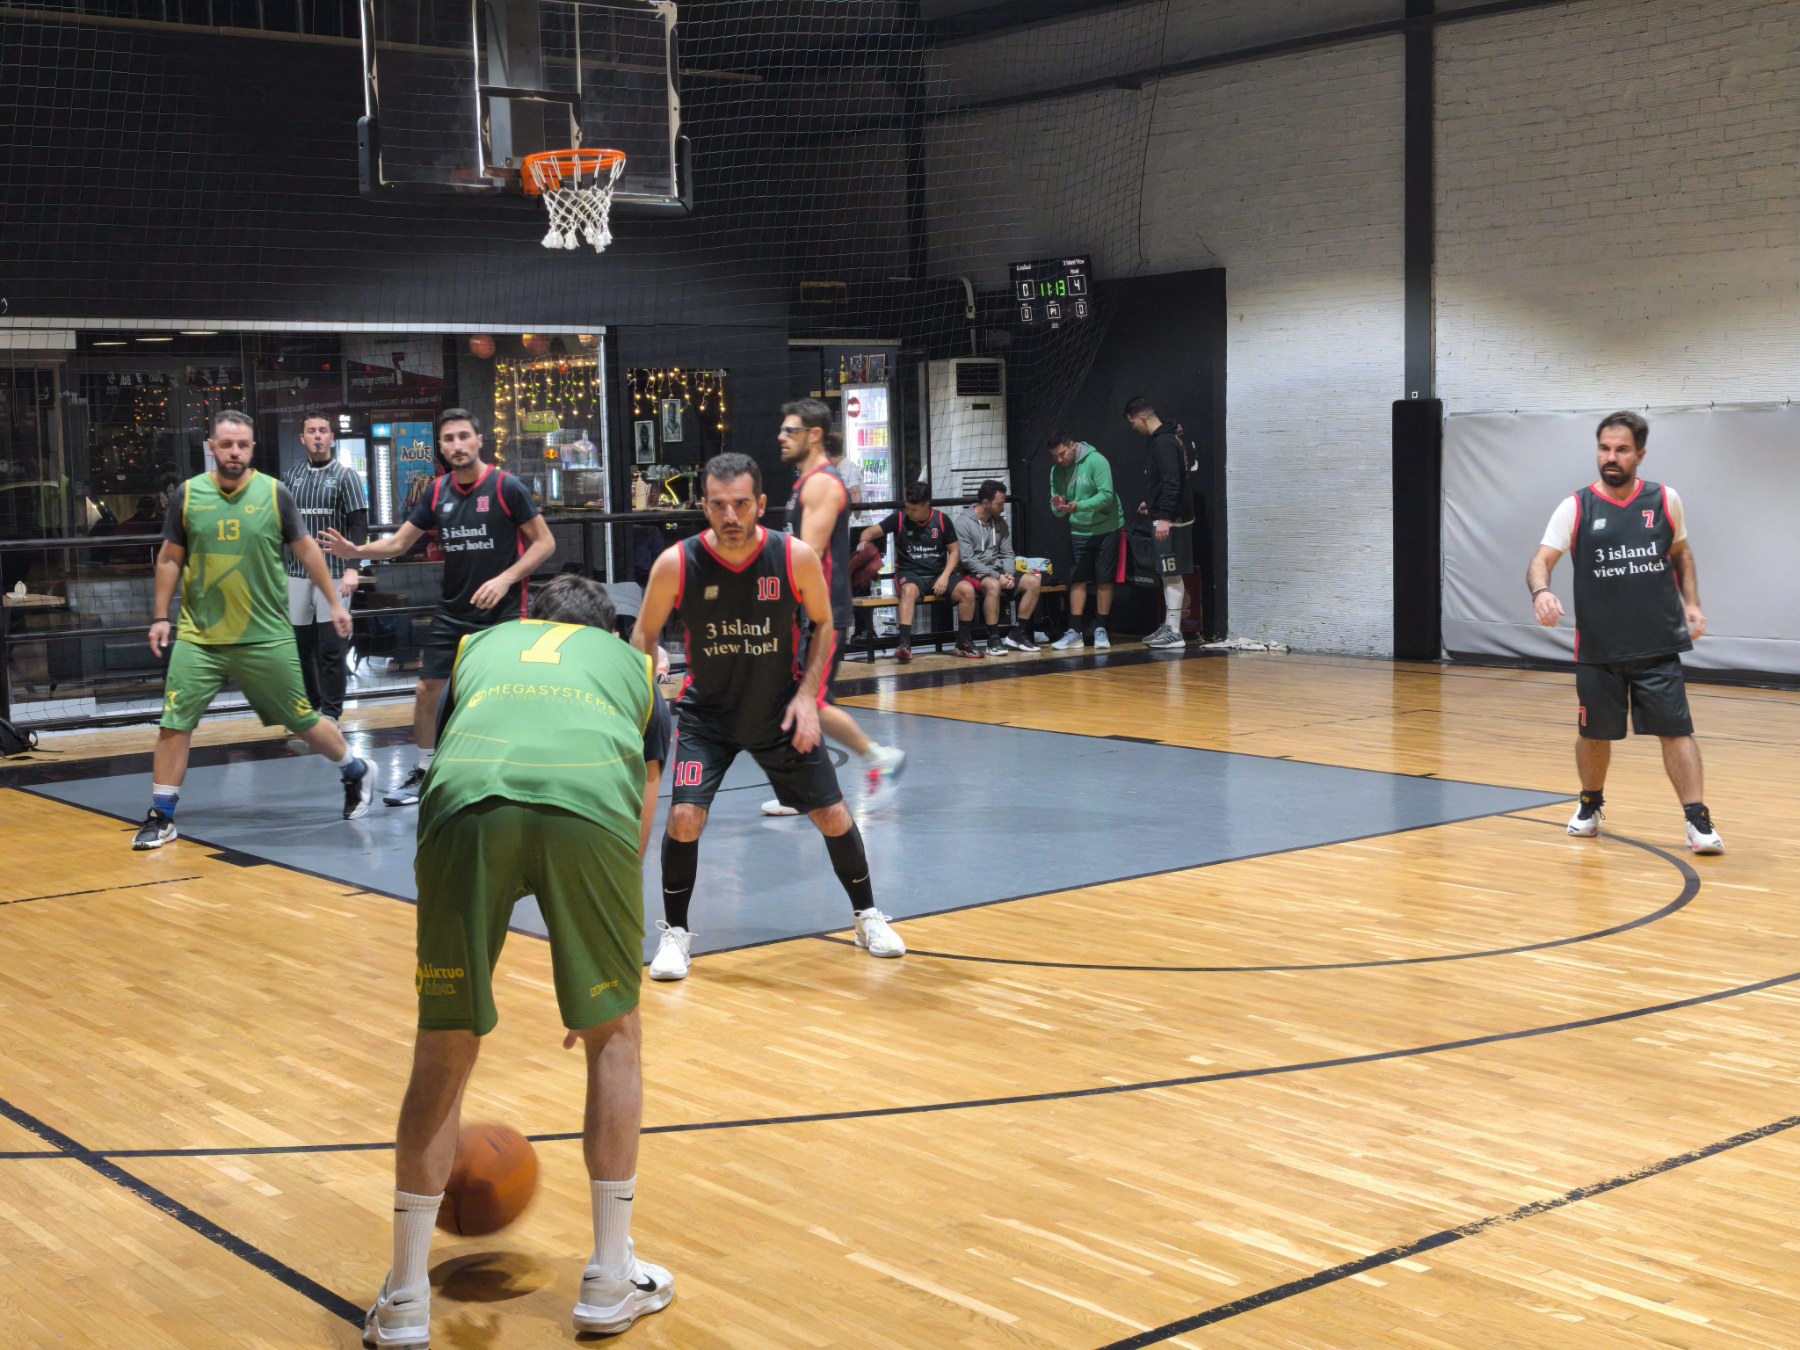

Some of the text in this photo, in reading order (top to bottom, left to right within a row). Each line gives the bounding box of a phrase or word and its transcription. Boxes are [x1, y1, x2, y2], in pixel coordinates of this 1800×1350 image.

[1022, 283, 1029, 297] 0
[1040, 280, 1066, 296] 11:13
[1073, 279, 1080, 291] 4
[1642, 509, 1655, 528] 7
[217, 519, 241, 541] 13
[441, 523, 488, 540] 3 island
[465, 537, 495, 550] hotel
[1595, 541, 1658, 563] 3 island
[1161, 557, 1177, 573] 16
[1592, 558, 1665, 578] view hotel
[757, 576, 780, 601] 10
[705, 616, 771, 640] 3 island
[520, 619, 588, 665] 7
[703, 638, 779, 658] view hotel
[675, 761, 703, 787] 10
